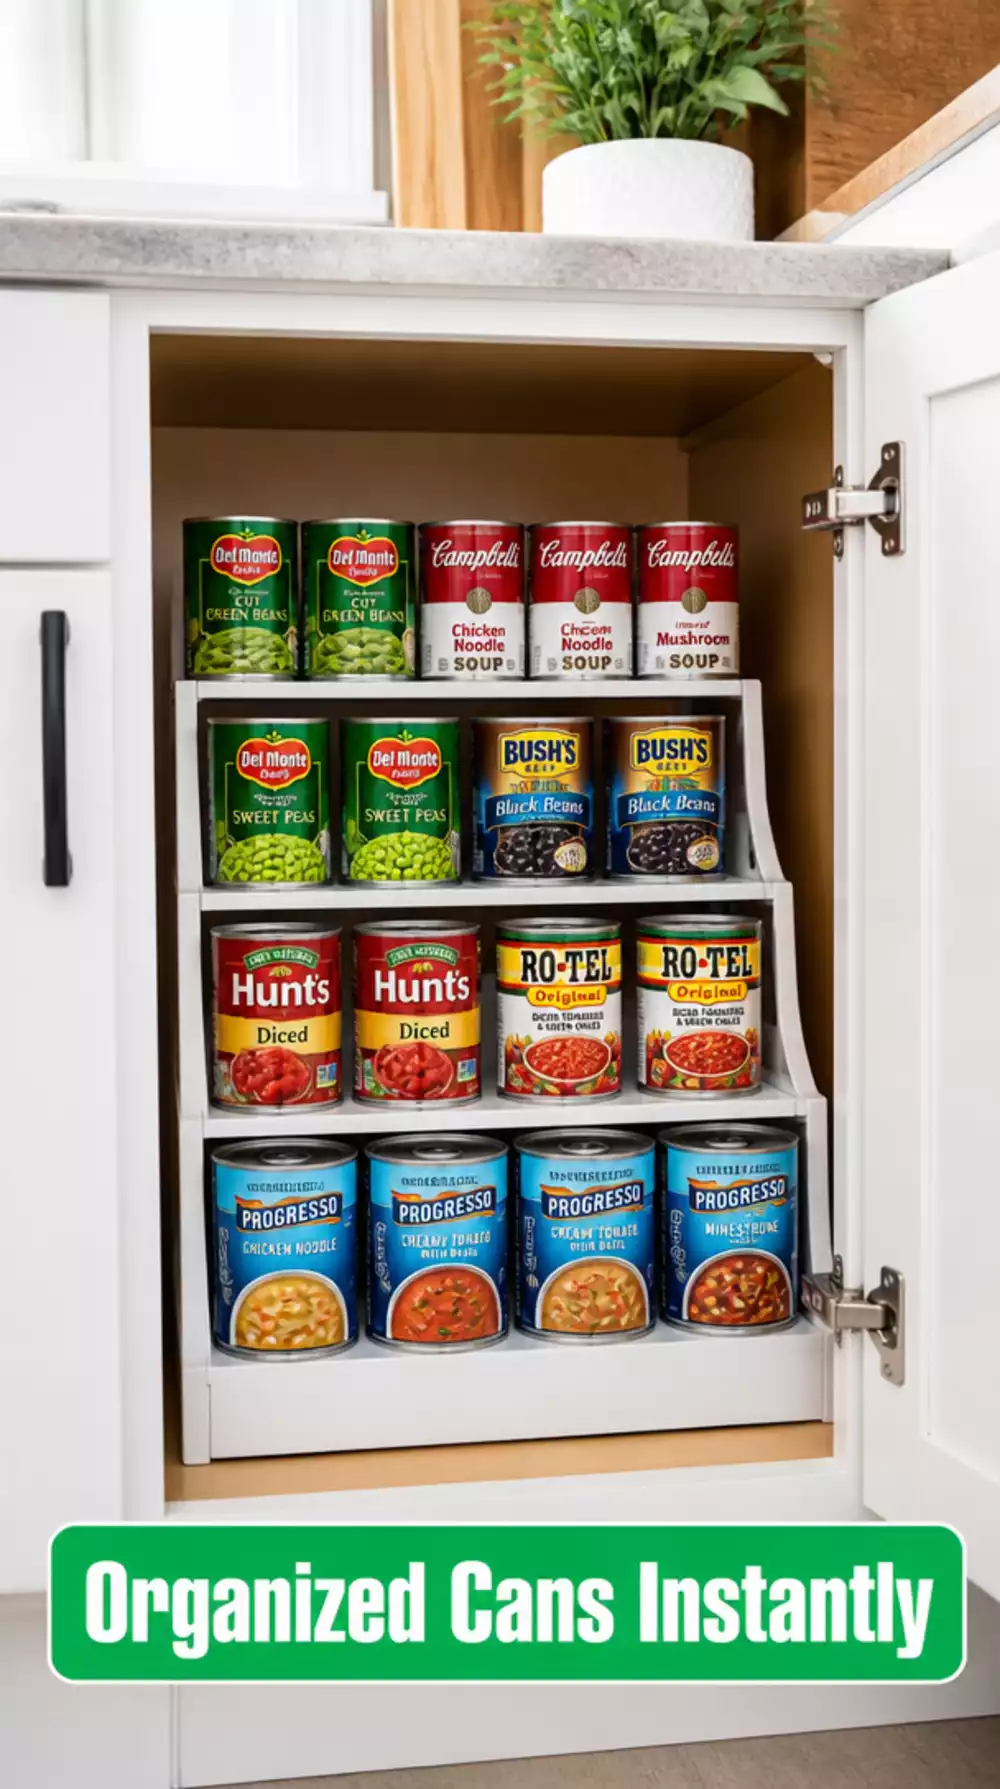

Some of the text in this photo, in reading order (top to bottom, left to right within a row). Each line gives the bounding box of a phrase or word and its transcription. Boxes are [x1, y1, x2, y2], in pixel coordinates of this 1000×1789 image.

[234, 596, 260, 608] CUT
[451, 622, 506, 637] Chicken
[656, 631, 730, 647] Mushroom
[453, 637, 505, 652] Noodle
[561, 637, 614, 652] Noodle
[453, 656, 504, 671] SOUP
[562, 655, 613, 670] SOUP
[669, 653, 720, 669] SOUP
[241, 750, 307, 768] Del Monte
[372, 750, 438, 768] Del Monte
[504, 739, 577, 765] BUSH'S
[637, 737, 708, 764] BUSH'S
[364, 807, 447, 823] SWEET PEAS
[543, 796, 584, 815] Beans
[233, 809, 315, 825] SWEET PEAS
[231, 971, 330, 1008] Hunt's
[374, 968, 470, 1004] Hunt's
[535, 986, 601, 1005] Original
[676, 982, 742, 1001] Original
[256, 1025, 309, 1045] Diced
[399, 1021, 450, 1041] Diced
[548, 1184, 642, 1218] PROGRESSO
[695, 1178, 786, 1211] PROGRESSO
[242, 1196, 338, 1230] PROGRESSO
[399, 1190, 492, 1224] PROGRESSO
[295, 1236, 337, 1256] NOODLE
